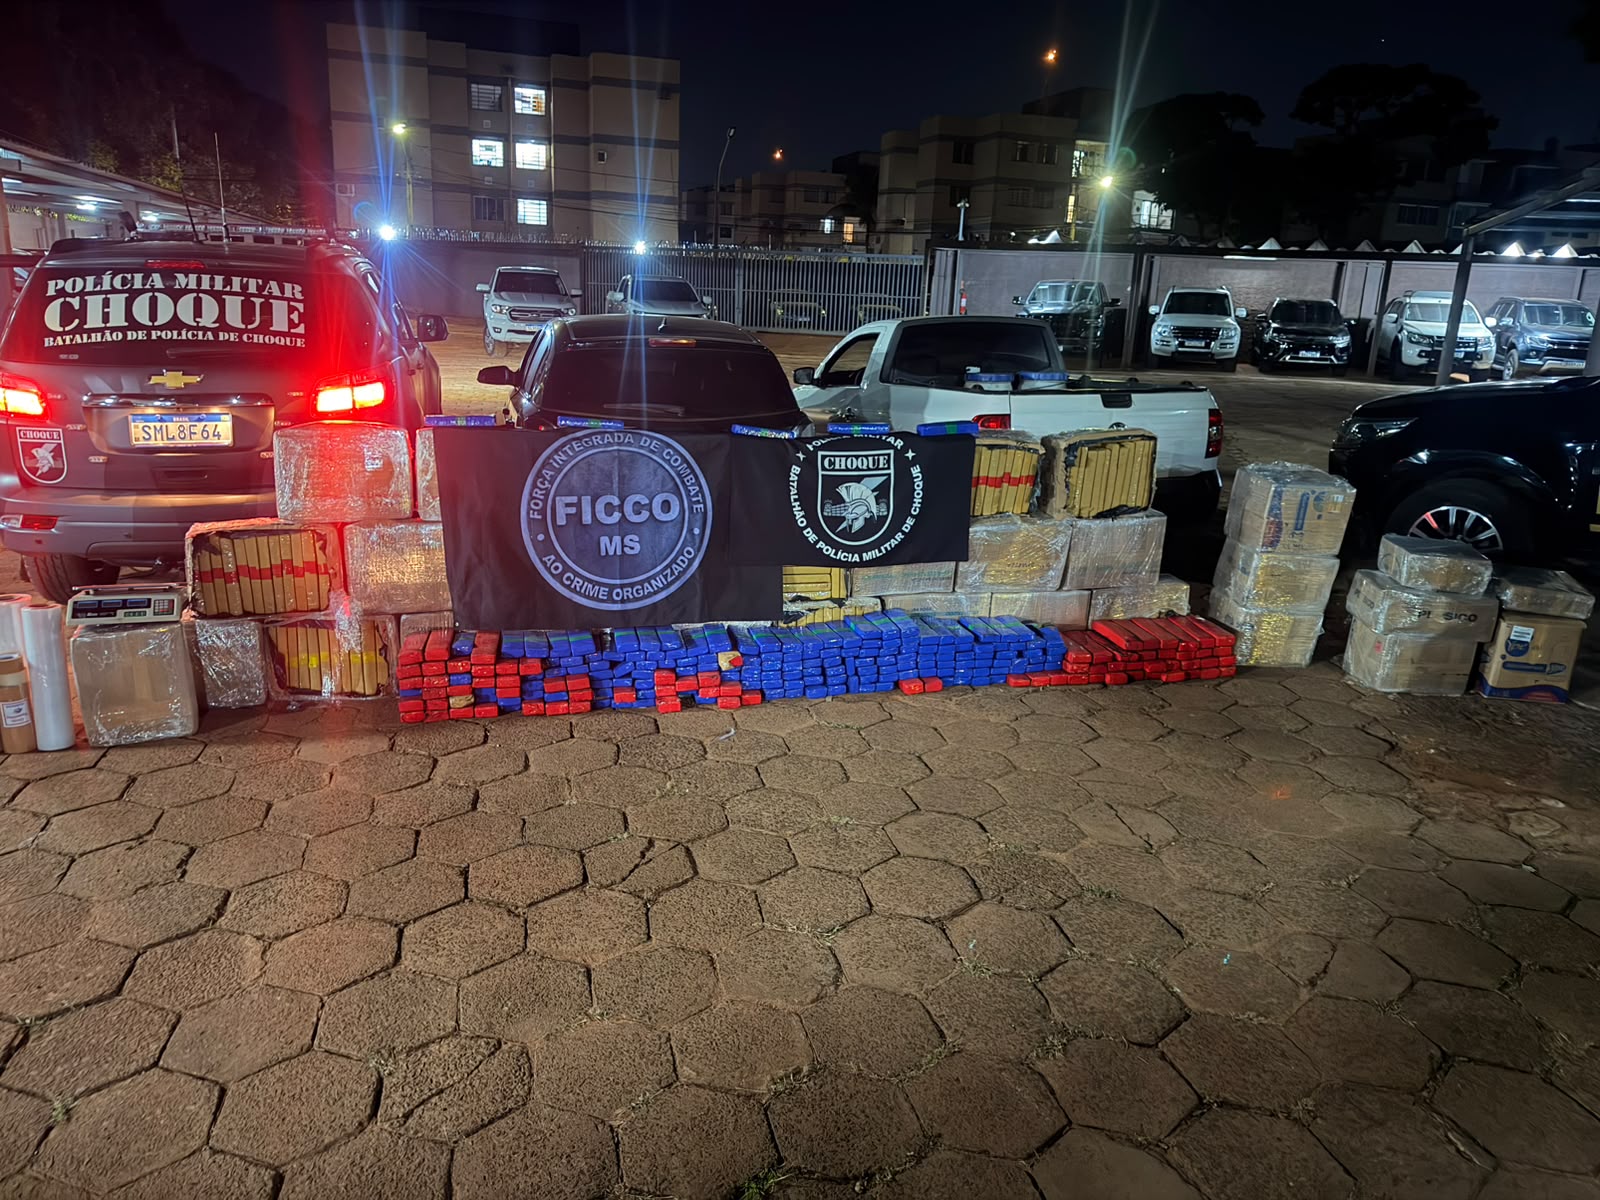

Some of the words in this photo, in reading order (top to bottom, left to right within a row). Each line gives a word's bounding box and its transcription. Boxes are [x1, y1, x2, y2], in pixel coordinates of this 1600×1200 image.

[45, 271, 165, 296] POLÍCIA
[173, 273, 304, 299] MILITAR
[44, 292, 305, 334] CHOQUE
[44, 330, 123, 347] BATALHÃO
[126, 330, 147, 340] DE
[151, 329, 214, 340] POLÍCIA
[218, 332, 239, 341] DE
[242, 333, 305, 347] CHOQUE
[20, 430, 60, 440] CHOQUE
[141, 424, 222, 441] SML8F64
[529, 469, 555, 519] FORÇA
[550, 432, 634, 468] INTEGRADA
[640, 436, 661, 452] DE
[662, 449, 704, 513] COMBATE
[823, 455, 889, 470] CHOQUE
[555, 492, 680, 526] FICCO
[789, 464, 807, 528] BATALHÃO
[802, 527, 819, 544] DE
[815, 540, 861, 563] POLÍCIA
[862, 532, 905, 562] MILITAR
[901, 516, 916, 533] DE
[910, 464, 924, 516] CHOQUE
[599, 534, 641, 556] MS
[542, 554, 563, 574] AO
[562, 572, 609, 600] CRIME
[612, 546, 695, 601] ORGANIZADO
